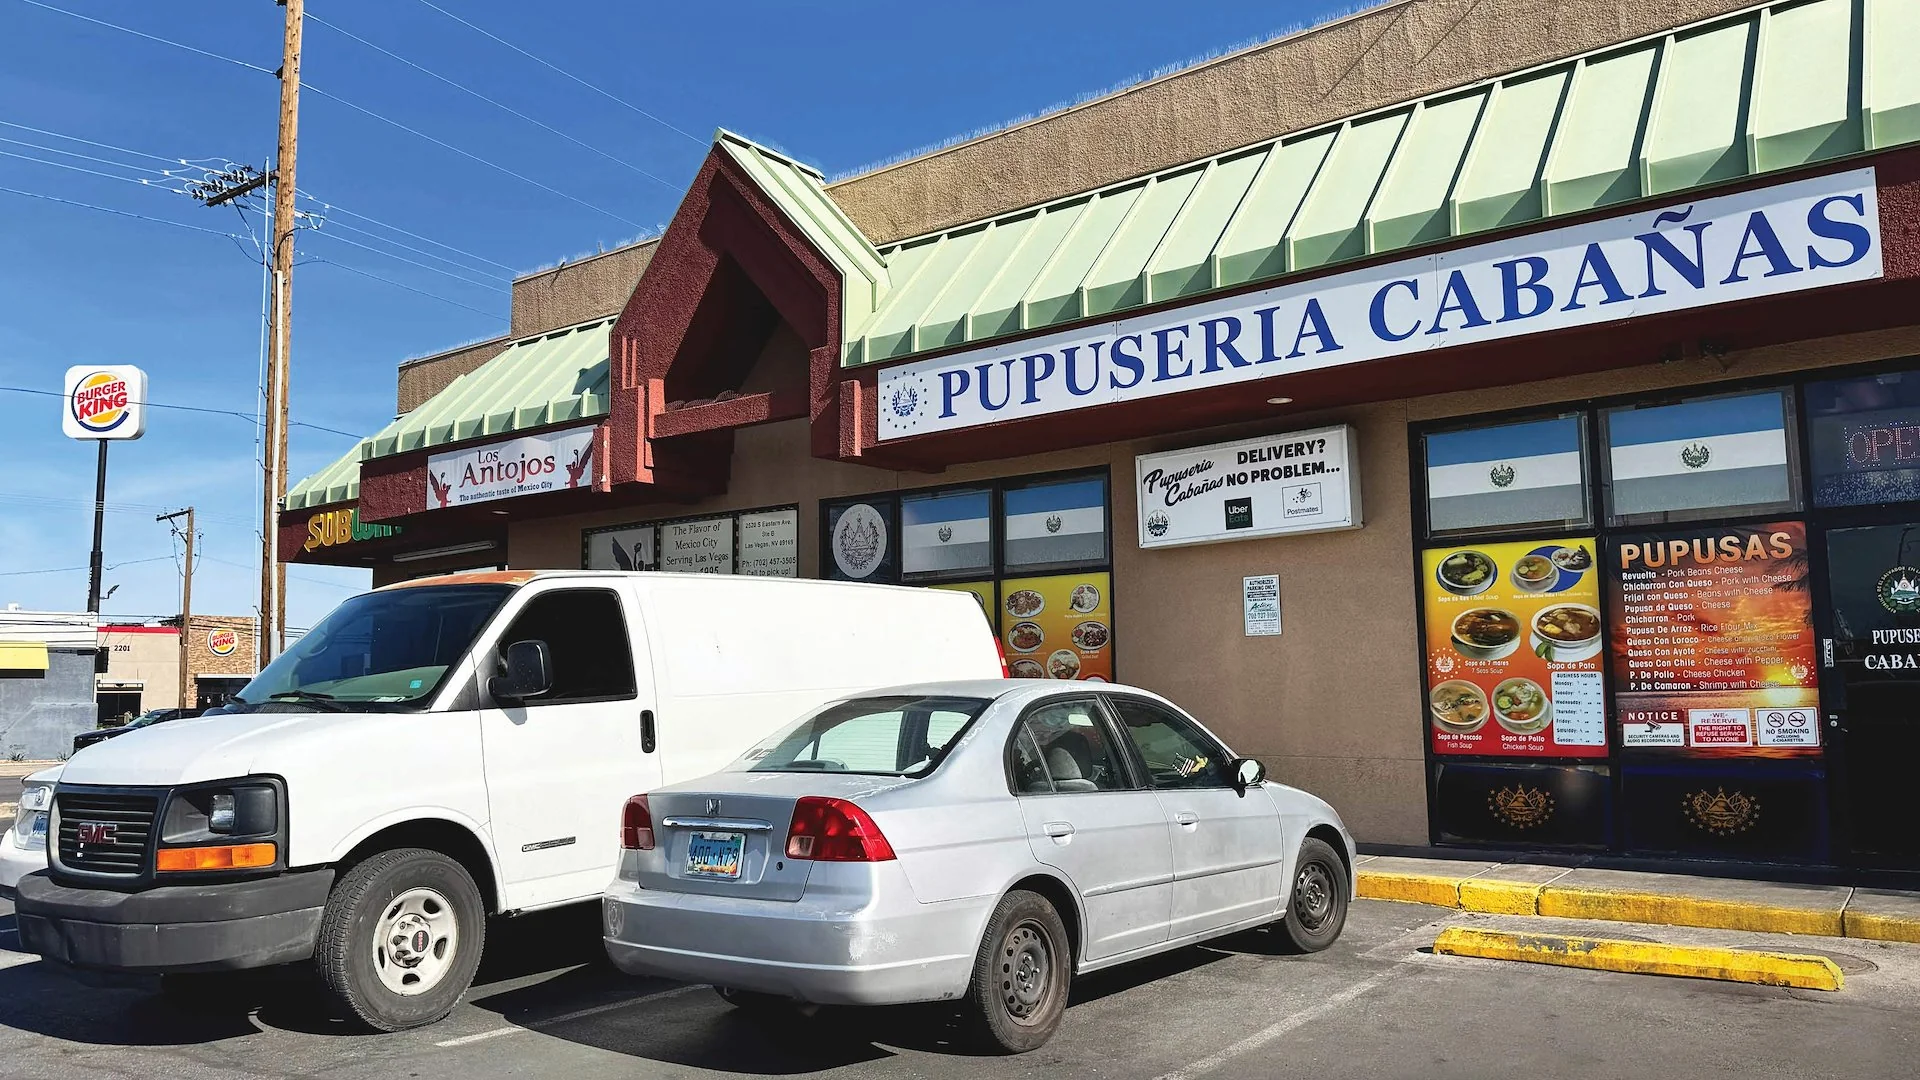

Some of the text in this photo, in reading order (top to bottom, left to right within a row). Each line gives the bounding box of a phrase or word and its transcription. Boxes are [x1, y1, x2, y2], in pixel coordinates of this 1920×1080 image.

[938, 192, 1872, 419] PUPUSERIA CABAÑAS
[77, 381, 126, 405] BURGER
[79, 392, 127, 420] KING
[1849, 426, 1920, 463] OPE
[477, 450, 499, 464] Los
[1237, 439, 1326, 465] DELIVERY?
[459, 453, 556, 488] Antojos
[1143, 459, 1214, 493] Pupuseria
[1226, 461, 1340, 487] NO PROBLEM...
[460, 494, 469, 502] The
[470, 490, 495, 500] authentic
[496, 488, 510, 496] taste
[517, 483, 539, 492] Mexico
[541, 481, 553, 489] City
[1164, 476, 1223, 507] Cabañas
[1228, 505, 1248, 514] Uber
[1287, 506, 1318, 516] Postmates
[1229, 514, 1248, 524] Eats
[673, 522, 721, 536] The Flavor of
[675, 538, 718, 550] Mexico City
[1620, 532, 1793, 569] PUPUSAS
[666, 552, 729, 566] Serving Las Vegas
[741, 560, 752, 568] Ph:
[753, 558, 768, 569] (702)
[1622, 566, 1743, 581] Revuelta Pork Beans Cheese
[1622, 574, 1792, 591] Chicharron Con Queso Pork with Cheese
[1623, 587, 1773, 603] Frijol con Queso Beans with Cheese
[1624, 601, 1731, 614] Pupusa de Queso Cheese
[1625, 613, 1696, 624] Chicharron Pork
[1626, 627, 1655, 636] Pupusa
[1657, 625, 1668, 634] De
[1670, 625, 1692, 633] Arroz
[1700, 623, 1718, 632] Rice
[212, 637, 235, 648] KING
[1626, 637, 1652, 646] Queso
[1653, 636, 1670, 645] Con
[1672, 636, 1699, 644] Loroco
[1707, 635, 1732, 643] Cheese
[114, 644, 131, 652] 2201
[1627, 645, 1746, 657] Queso Con Ayote Cheese with
[1546, 661, 1595, 670] Sopa de Pata
[1628, 655, 1784, 668] Queso Con Chile Cheese with Pepper
[1863, 653, 1920, 670] CABA
[1629, 668, 1745, 679] P. De Pollo Cheese Chicken
[1630, 679, 1780, 690] P. De Camaron Shrimp with Cheese
[1628, 711, 1678, 720] NOTICE
[1437, 733, 1451, 741] Sopa
[1460, 733, 1482, 741] Pescado
[1501, 734, 1517, 742] Sopa
[1528, 743, 1544, 751] Soup
[77, 822, 118, 844] GMC
